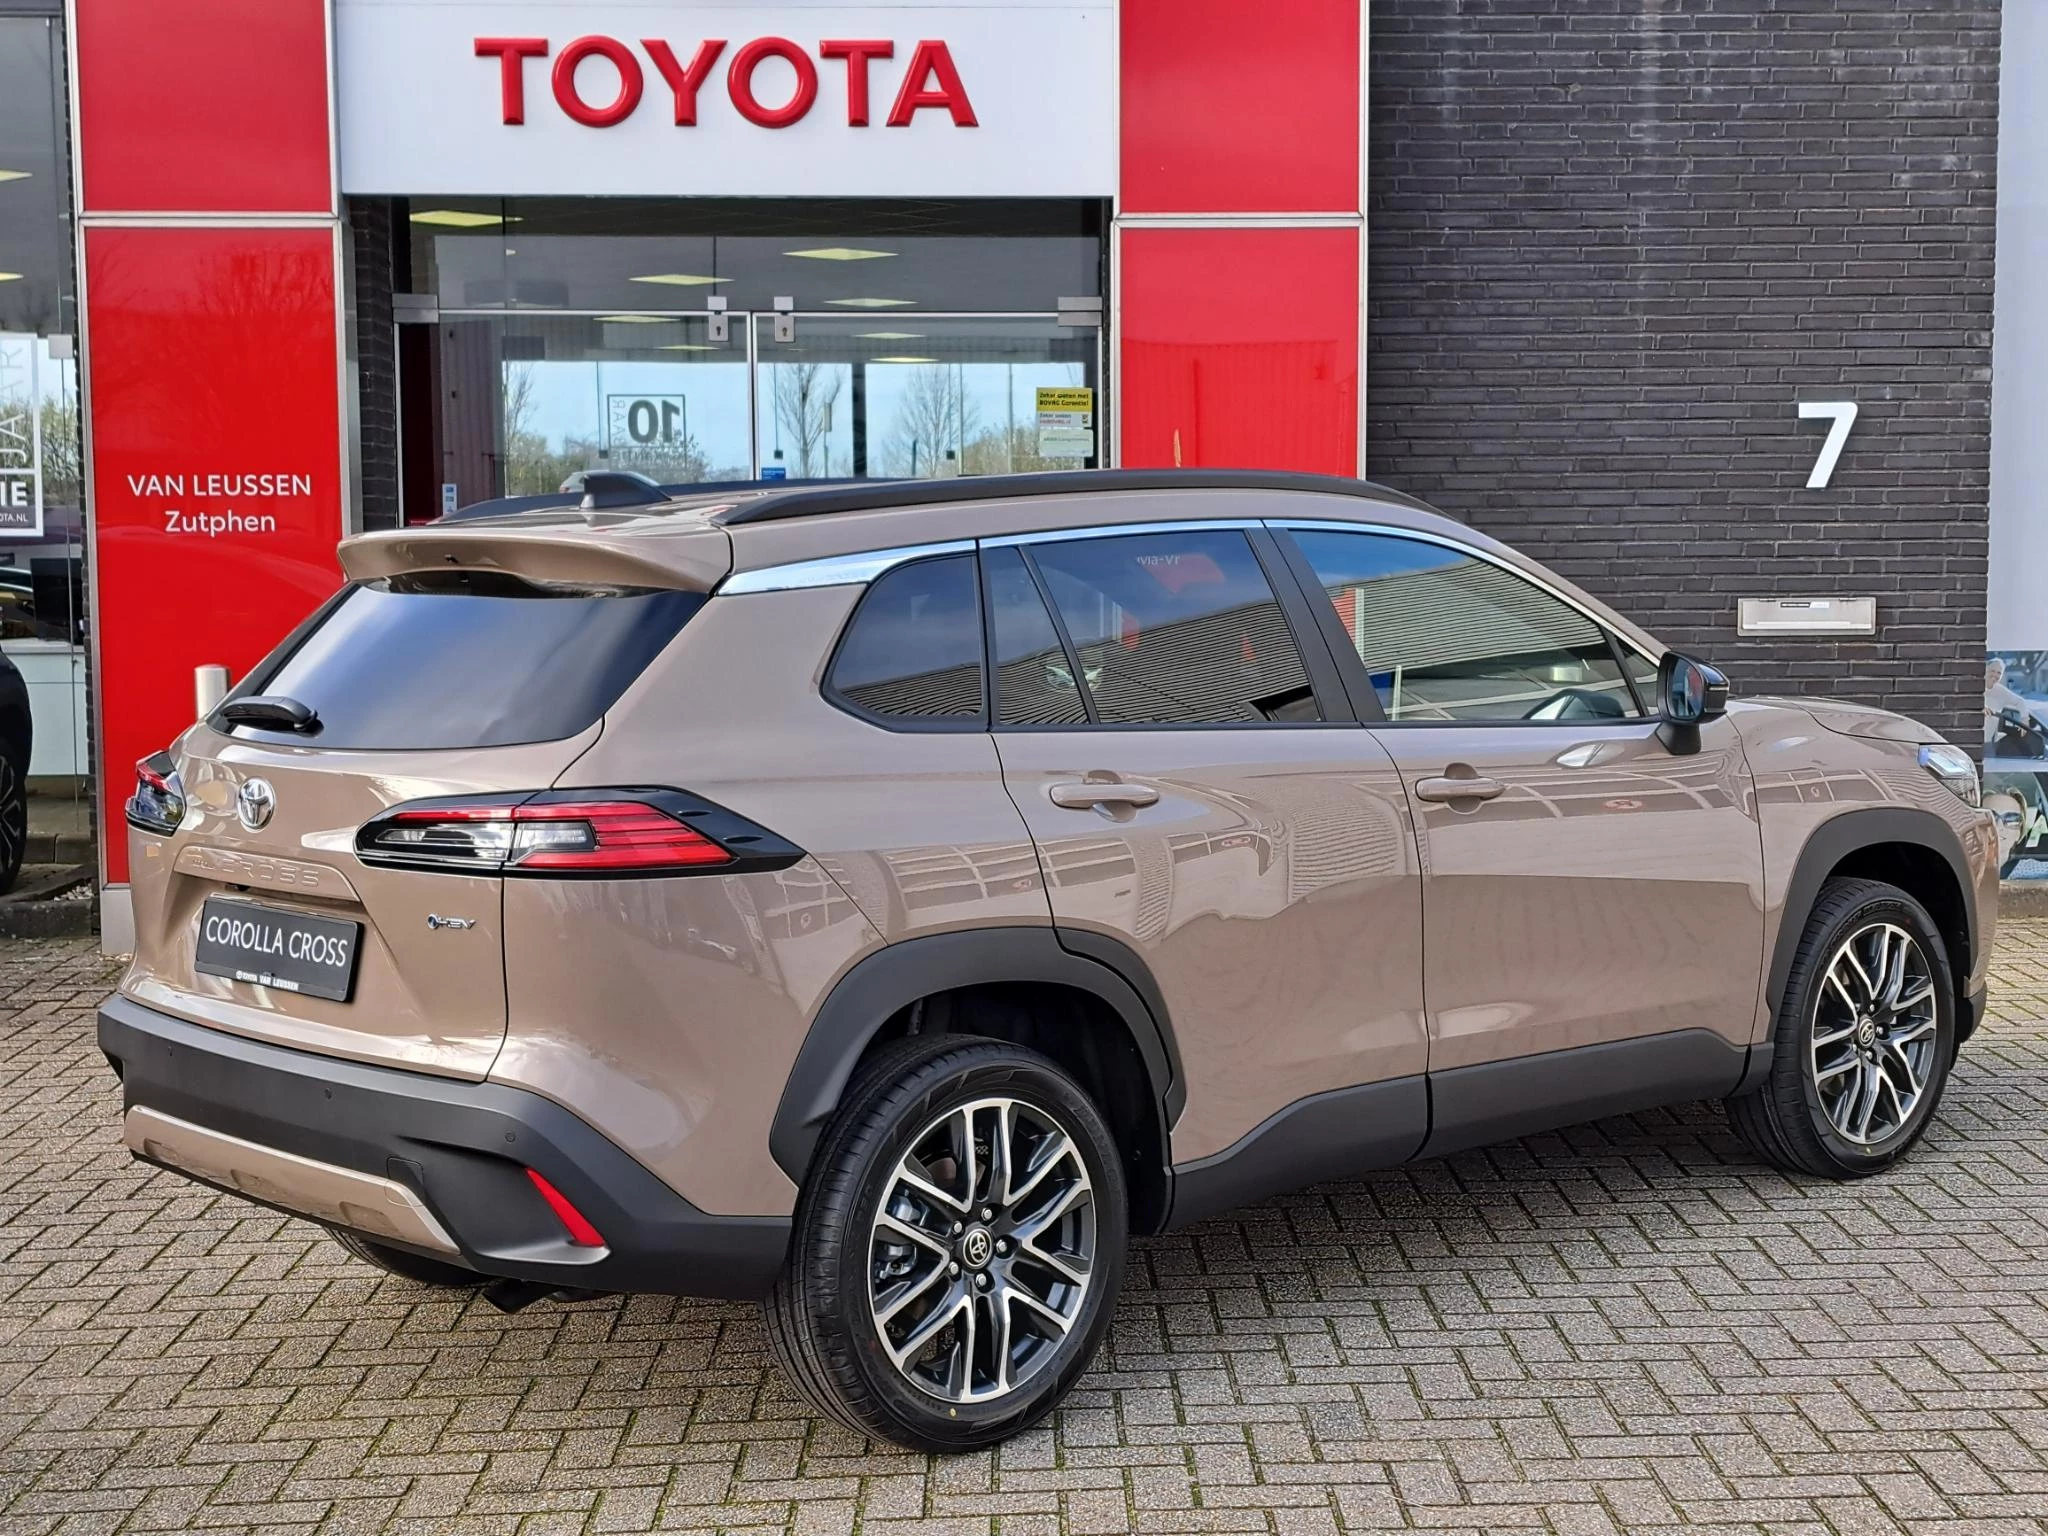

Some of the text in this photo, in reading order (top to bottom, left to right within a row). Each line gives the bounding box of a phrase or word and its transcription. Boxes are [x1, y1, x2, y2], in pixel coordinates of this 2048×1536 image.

[474, 35, 978, 129] TOYOTA
[1798, 401, 1859, 489] 7
[127, 474, 311, 496] VAN LEUSSEN
[164, 509, 276, 537] Zutphen
[206, 916, 348, 967] COROLLA CROSS
